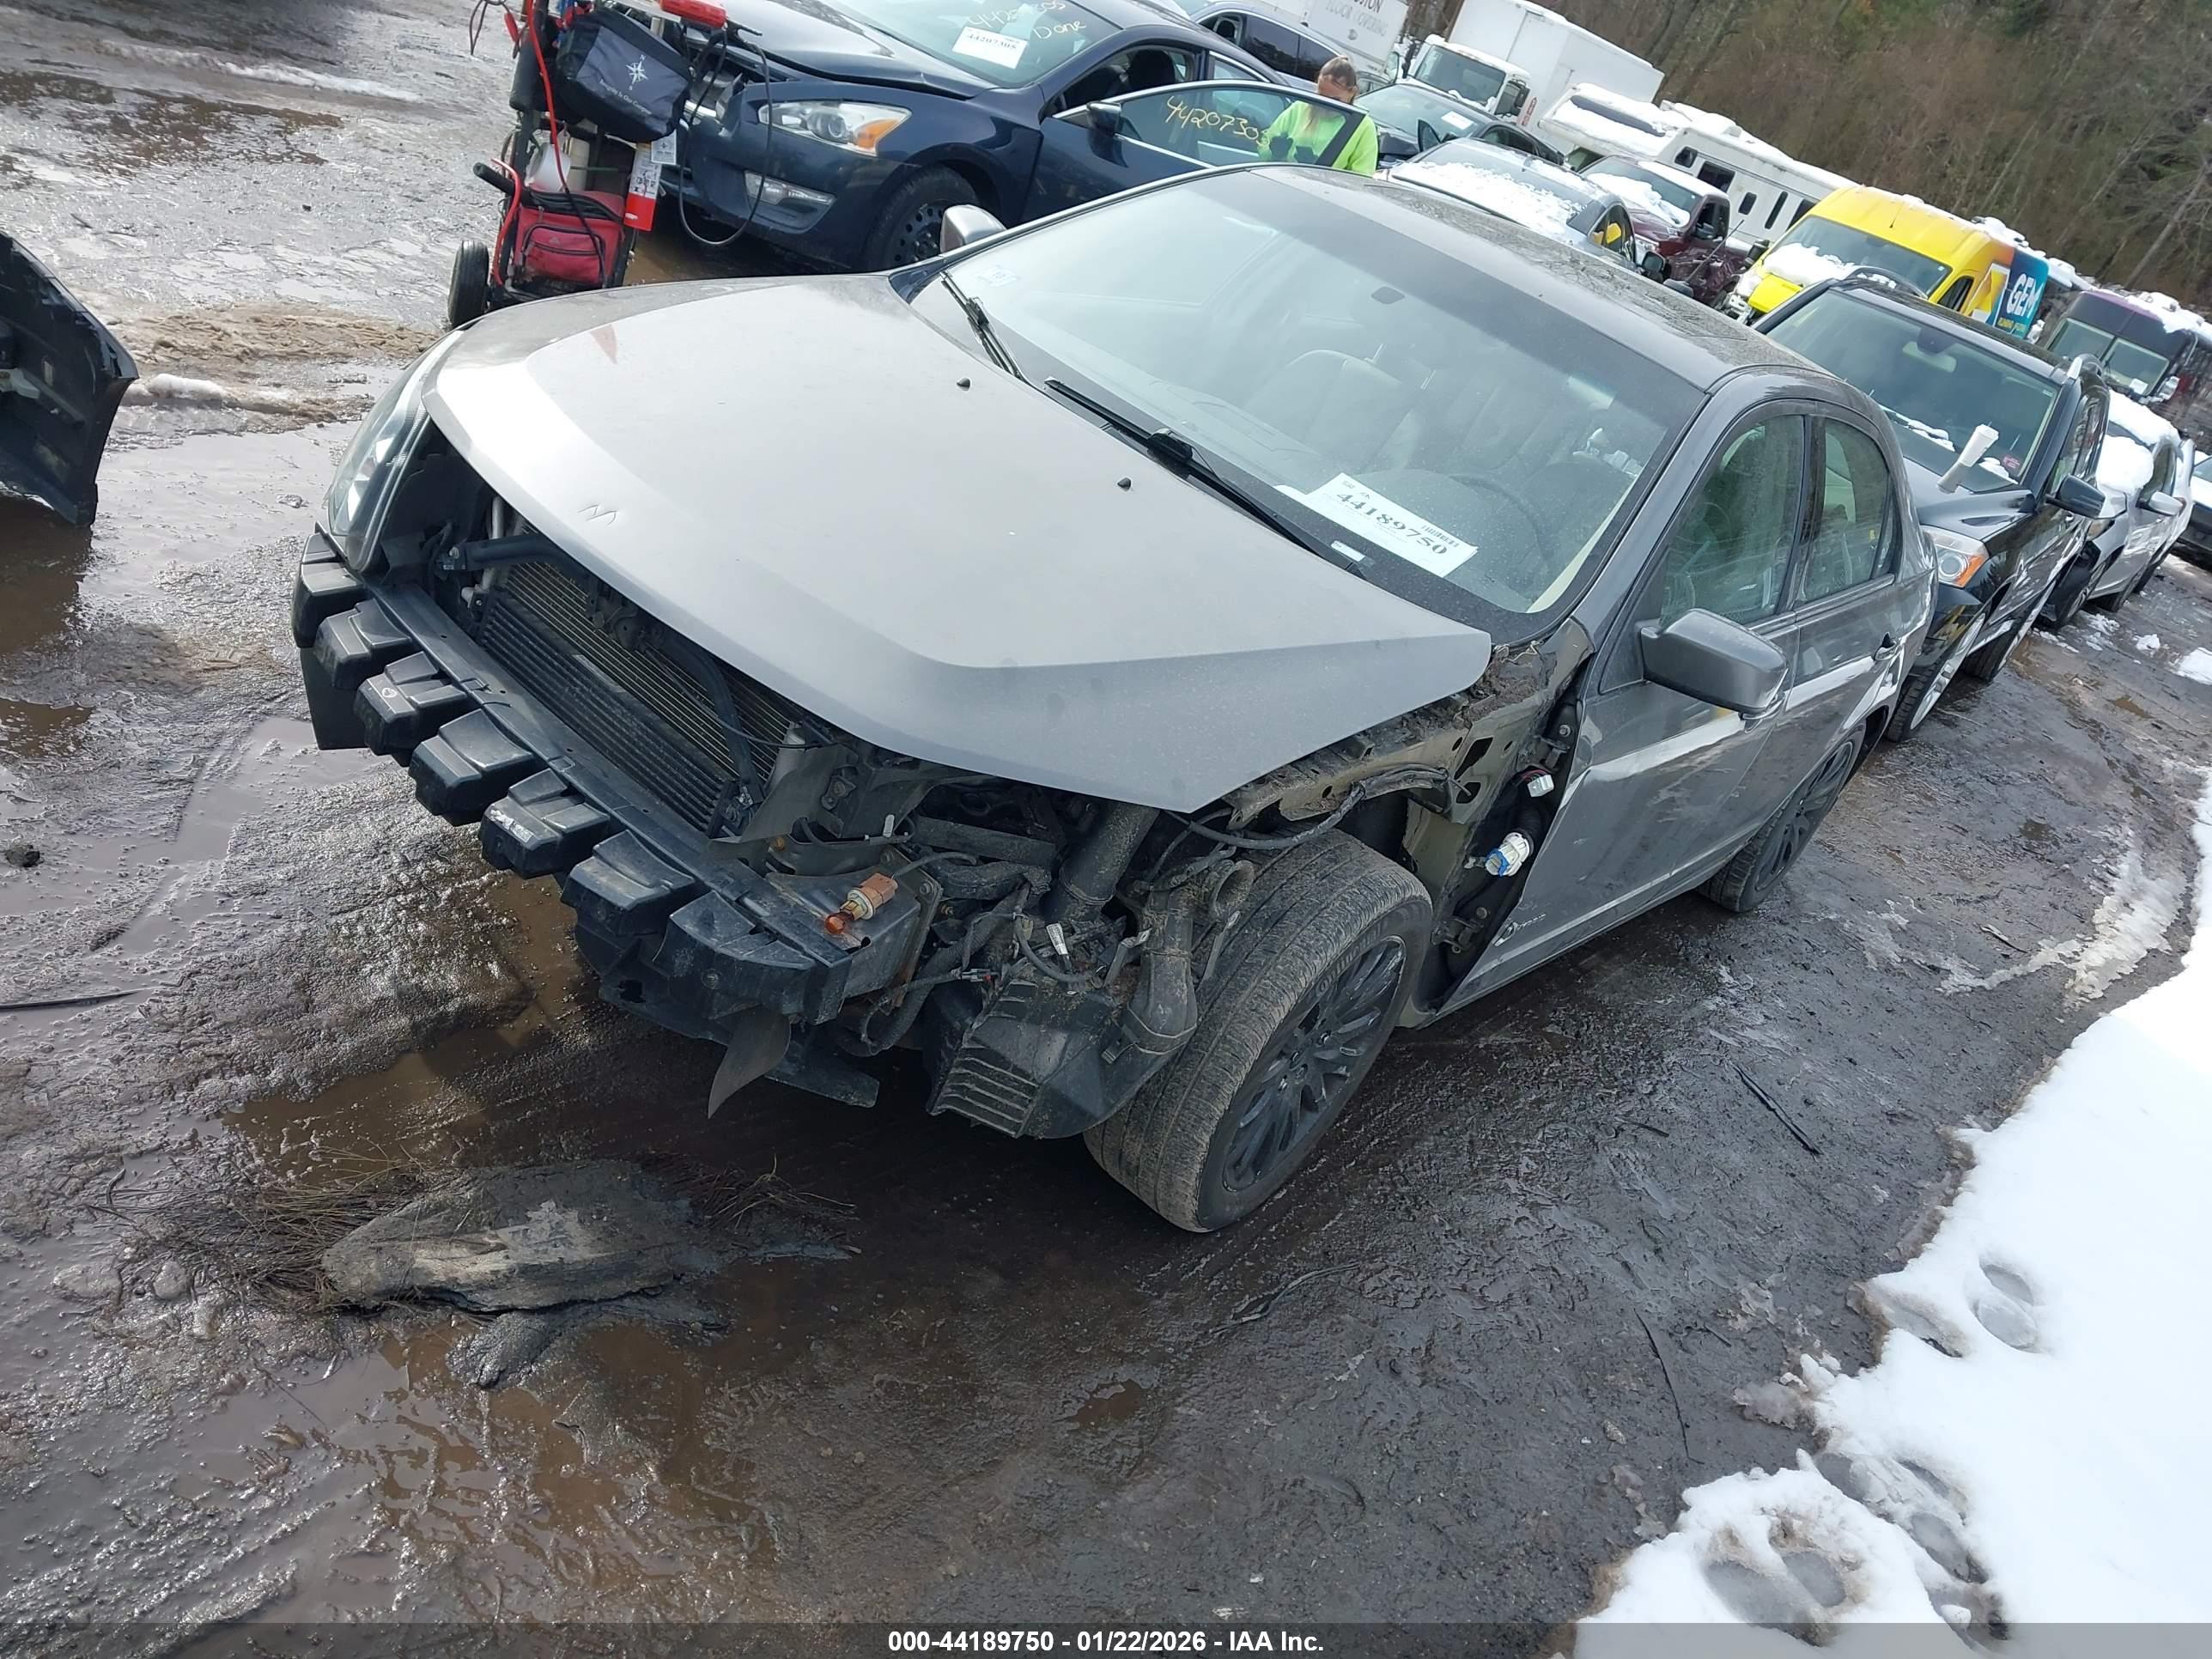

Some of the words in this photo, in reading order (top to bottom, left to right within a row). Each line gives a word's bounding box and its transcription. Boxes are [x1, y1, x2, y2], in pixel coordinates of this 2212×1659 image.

[1033, 20, 1086, 40] Done
[1165, 95, 1271, 148] 44207305
[2007, 273, 2044, 318] GEM
[1336, 494, 1448, 555] 44189750
